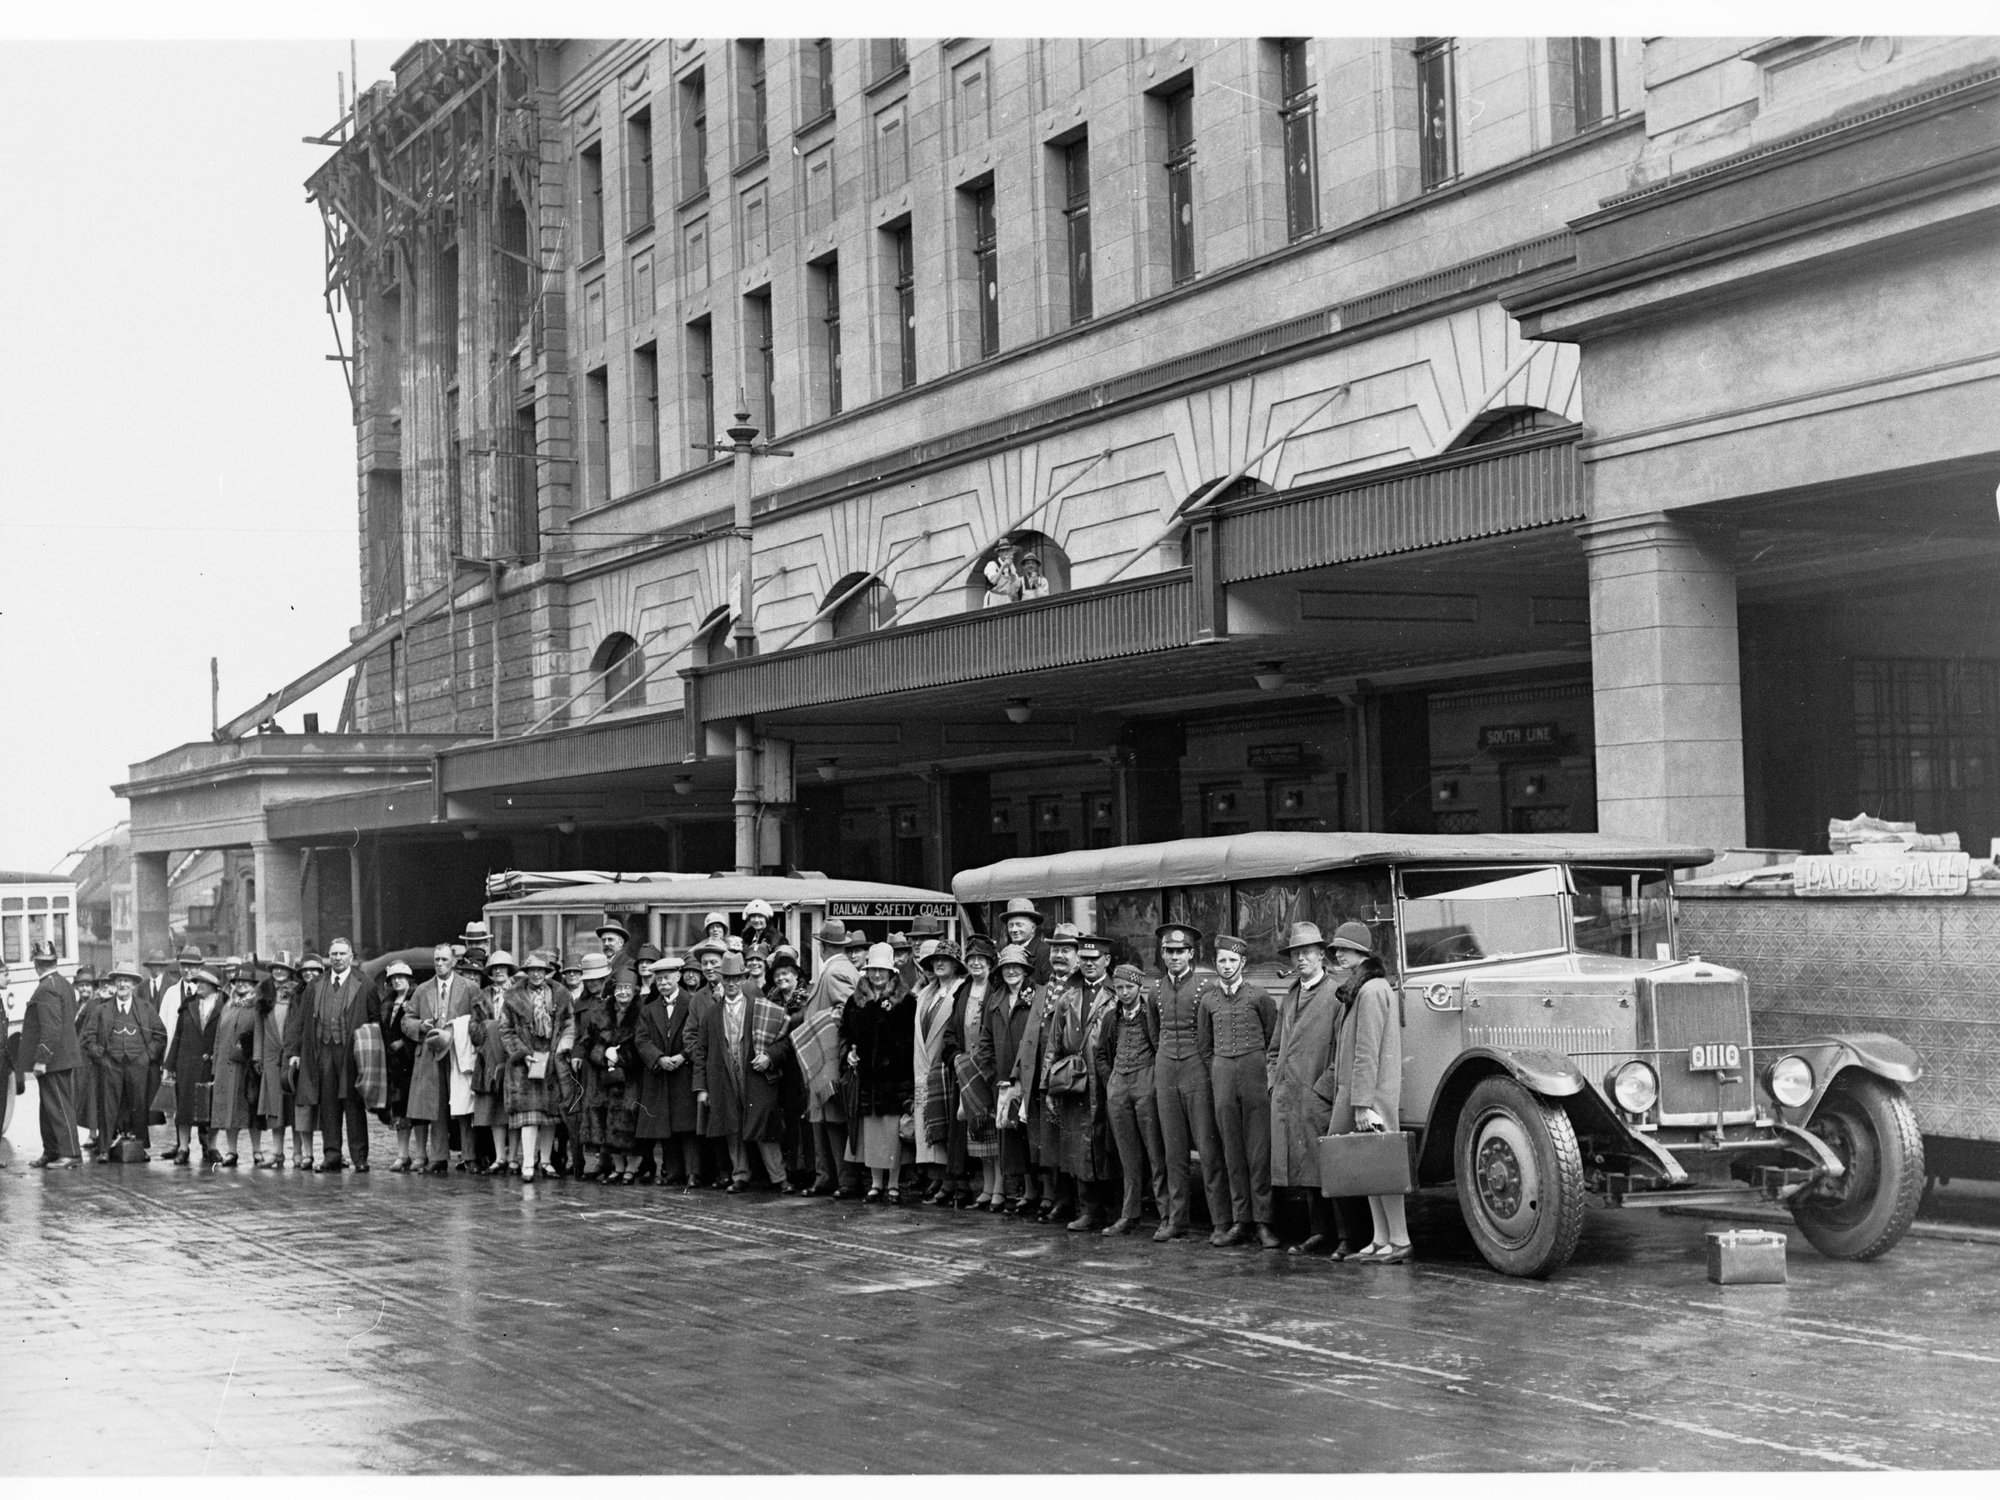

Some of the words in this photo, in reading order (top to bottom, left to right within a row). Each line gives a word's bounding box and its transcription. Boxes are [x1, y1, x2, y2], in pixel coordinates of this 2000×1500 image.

[1487, 728, 1521, 744] SOUTH
[1526, 727, 1552, 742] LINE
[1806, 860, 1879, 891] PAPER
[1889, 855, 1960, 891] STALL
[832, 903, 869, 916] RAILWAY
[875, 903, 915, 916] SAFETY
[919, 903, 953, 917] COACH
